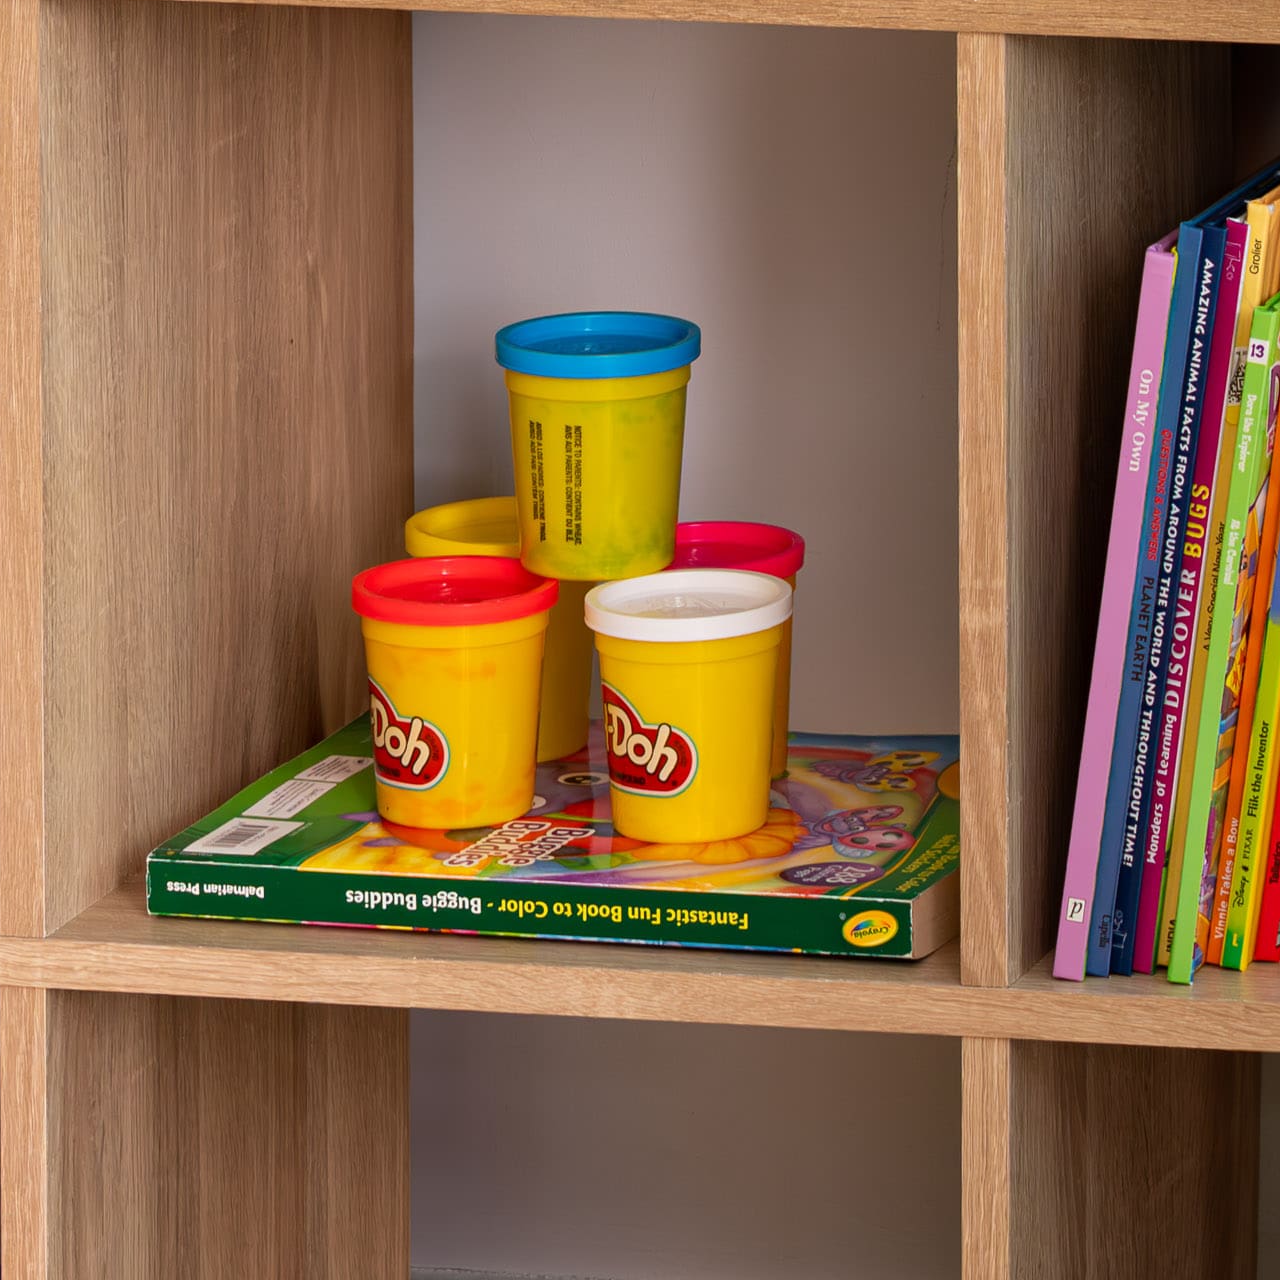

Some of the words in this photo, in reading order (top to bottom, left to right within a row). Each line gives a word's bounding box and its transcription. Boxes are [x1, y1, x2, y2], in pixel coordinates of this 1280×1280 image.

[1250, 239, 1262, 274] Grolier
[1195, 258, 1215, 335] AMAZING
[1250, 344, 1264, 358] 13
[1139, 369, 1153, 395] On
[1186, 339, 1204, 402] ANIMAL
[1133, 401, 1150, 427] My
[1245, 394, 1257, 414] Dora
[1179, 405, 1194, 452] FACTS
[1243, 419, 1253, 433] the
[1130, 433, 1145, 472] Own
[1156, 429, 1173, 495] QUESTIONS
[1238, 434, 1252, 472] Explorer
[1172, 456, 1188, 500] FROM
[1147, 509, 1163, 561] ANSWERS
[1184, 483, 1209, 559] BUGS
[1164, 504, 1180, 574] AROUND
[1137, 576, 1155, 634] PLANET
[1157, 577, 1171, 607] THE
[1151, 613, 1166, 668] WORLD
[1163, 569, 1197, 709] DISCOVER
[1131, 635, 1147, 682] EARTH
[1145, 670, 1158, 705] AND
[1158, 714, 1177, 776] Learning
[1255, 720, 1269, 769] Inventor
[1129, 710, 1153, 820] THROUGHOUT
[1252, 770, 1262, 792] the
[1156, 779, 1168, 797] of
[1247, 794, 1259, 817] Flik
[443, 821, 552, 868] Buddies
[500, 827, 595, 867] Buggie
[1123, 825, 1137, 867] TIME!
[1146, 804, 1163, 864] Wonders
[1227, 819, 1239, 844] Bow
[1242, 829, 1253, 859] PIXAR
[167, 881, 200, 895] Press
[204, 883, 264, 898] Dalmatian
[1220, 860, 1233, 895] Takes
[1232, 876, 1249, 908] Disney
[345, 889, 417, 909] Buddies
[422, 892, 481, 914] Buggie
[498, 899, 548, 917] Color
[553, 902, 572, 918] to
[577, 903, 622, 921] Book
[628, 905, 660, 924] Fun
[666, 908, 748, 929] Fantastic
[854, 926, 889, 939] Crayola
[1215, 902, 1227, 939] Vinnie
